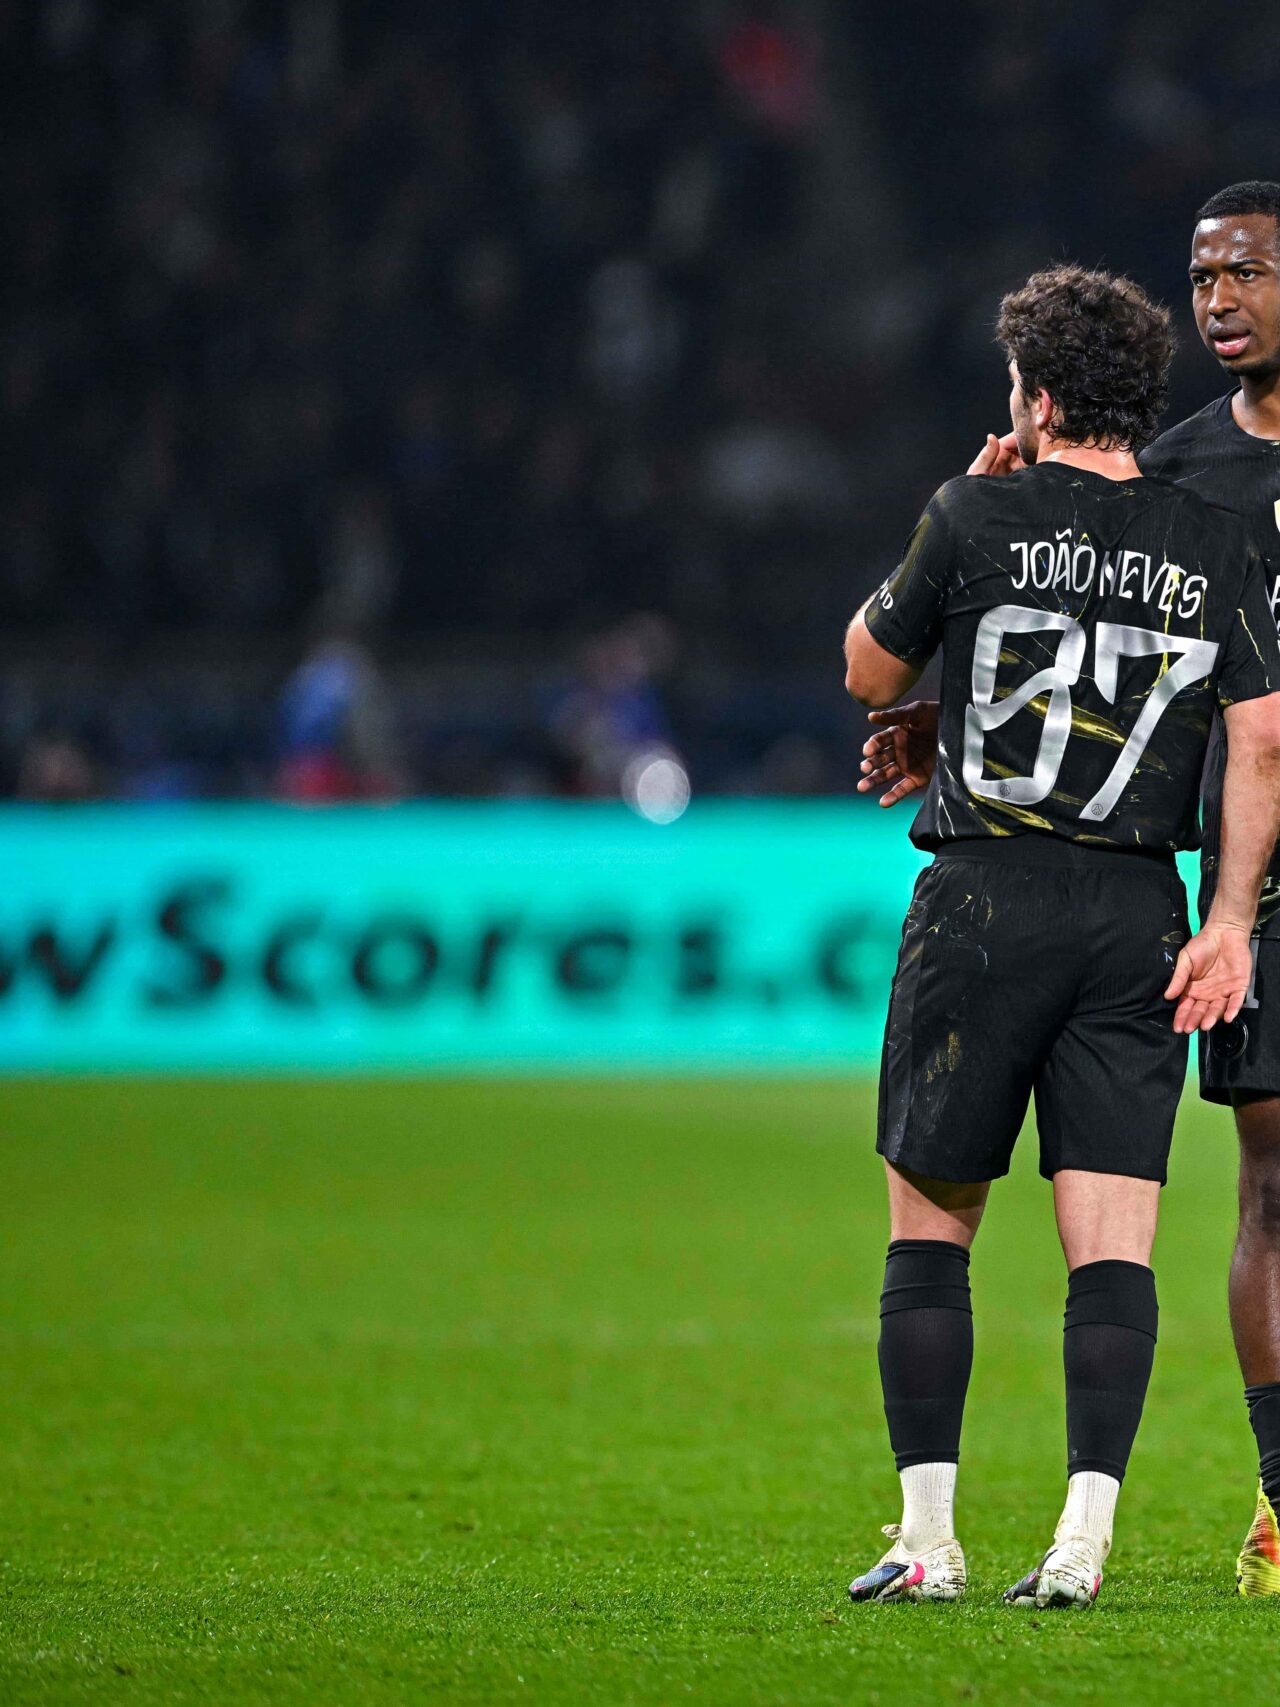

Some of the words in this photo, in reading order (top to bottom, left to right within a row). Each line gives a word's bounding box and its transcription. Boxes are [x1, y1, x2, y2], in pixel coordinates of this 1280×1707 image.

[1010, 528, 1097, 594] JOÃO
[1099, 549, 1208, 619] NEVES
[962, 604, 1220, 822] 87
